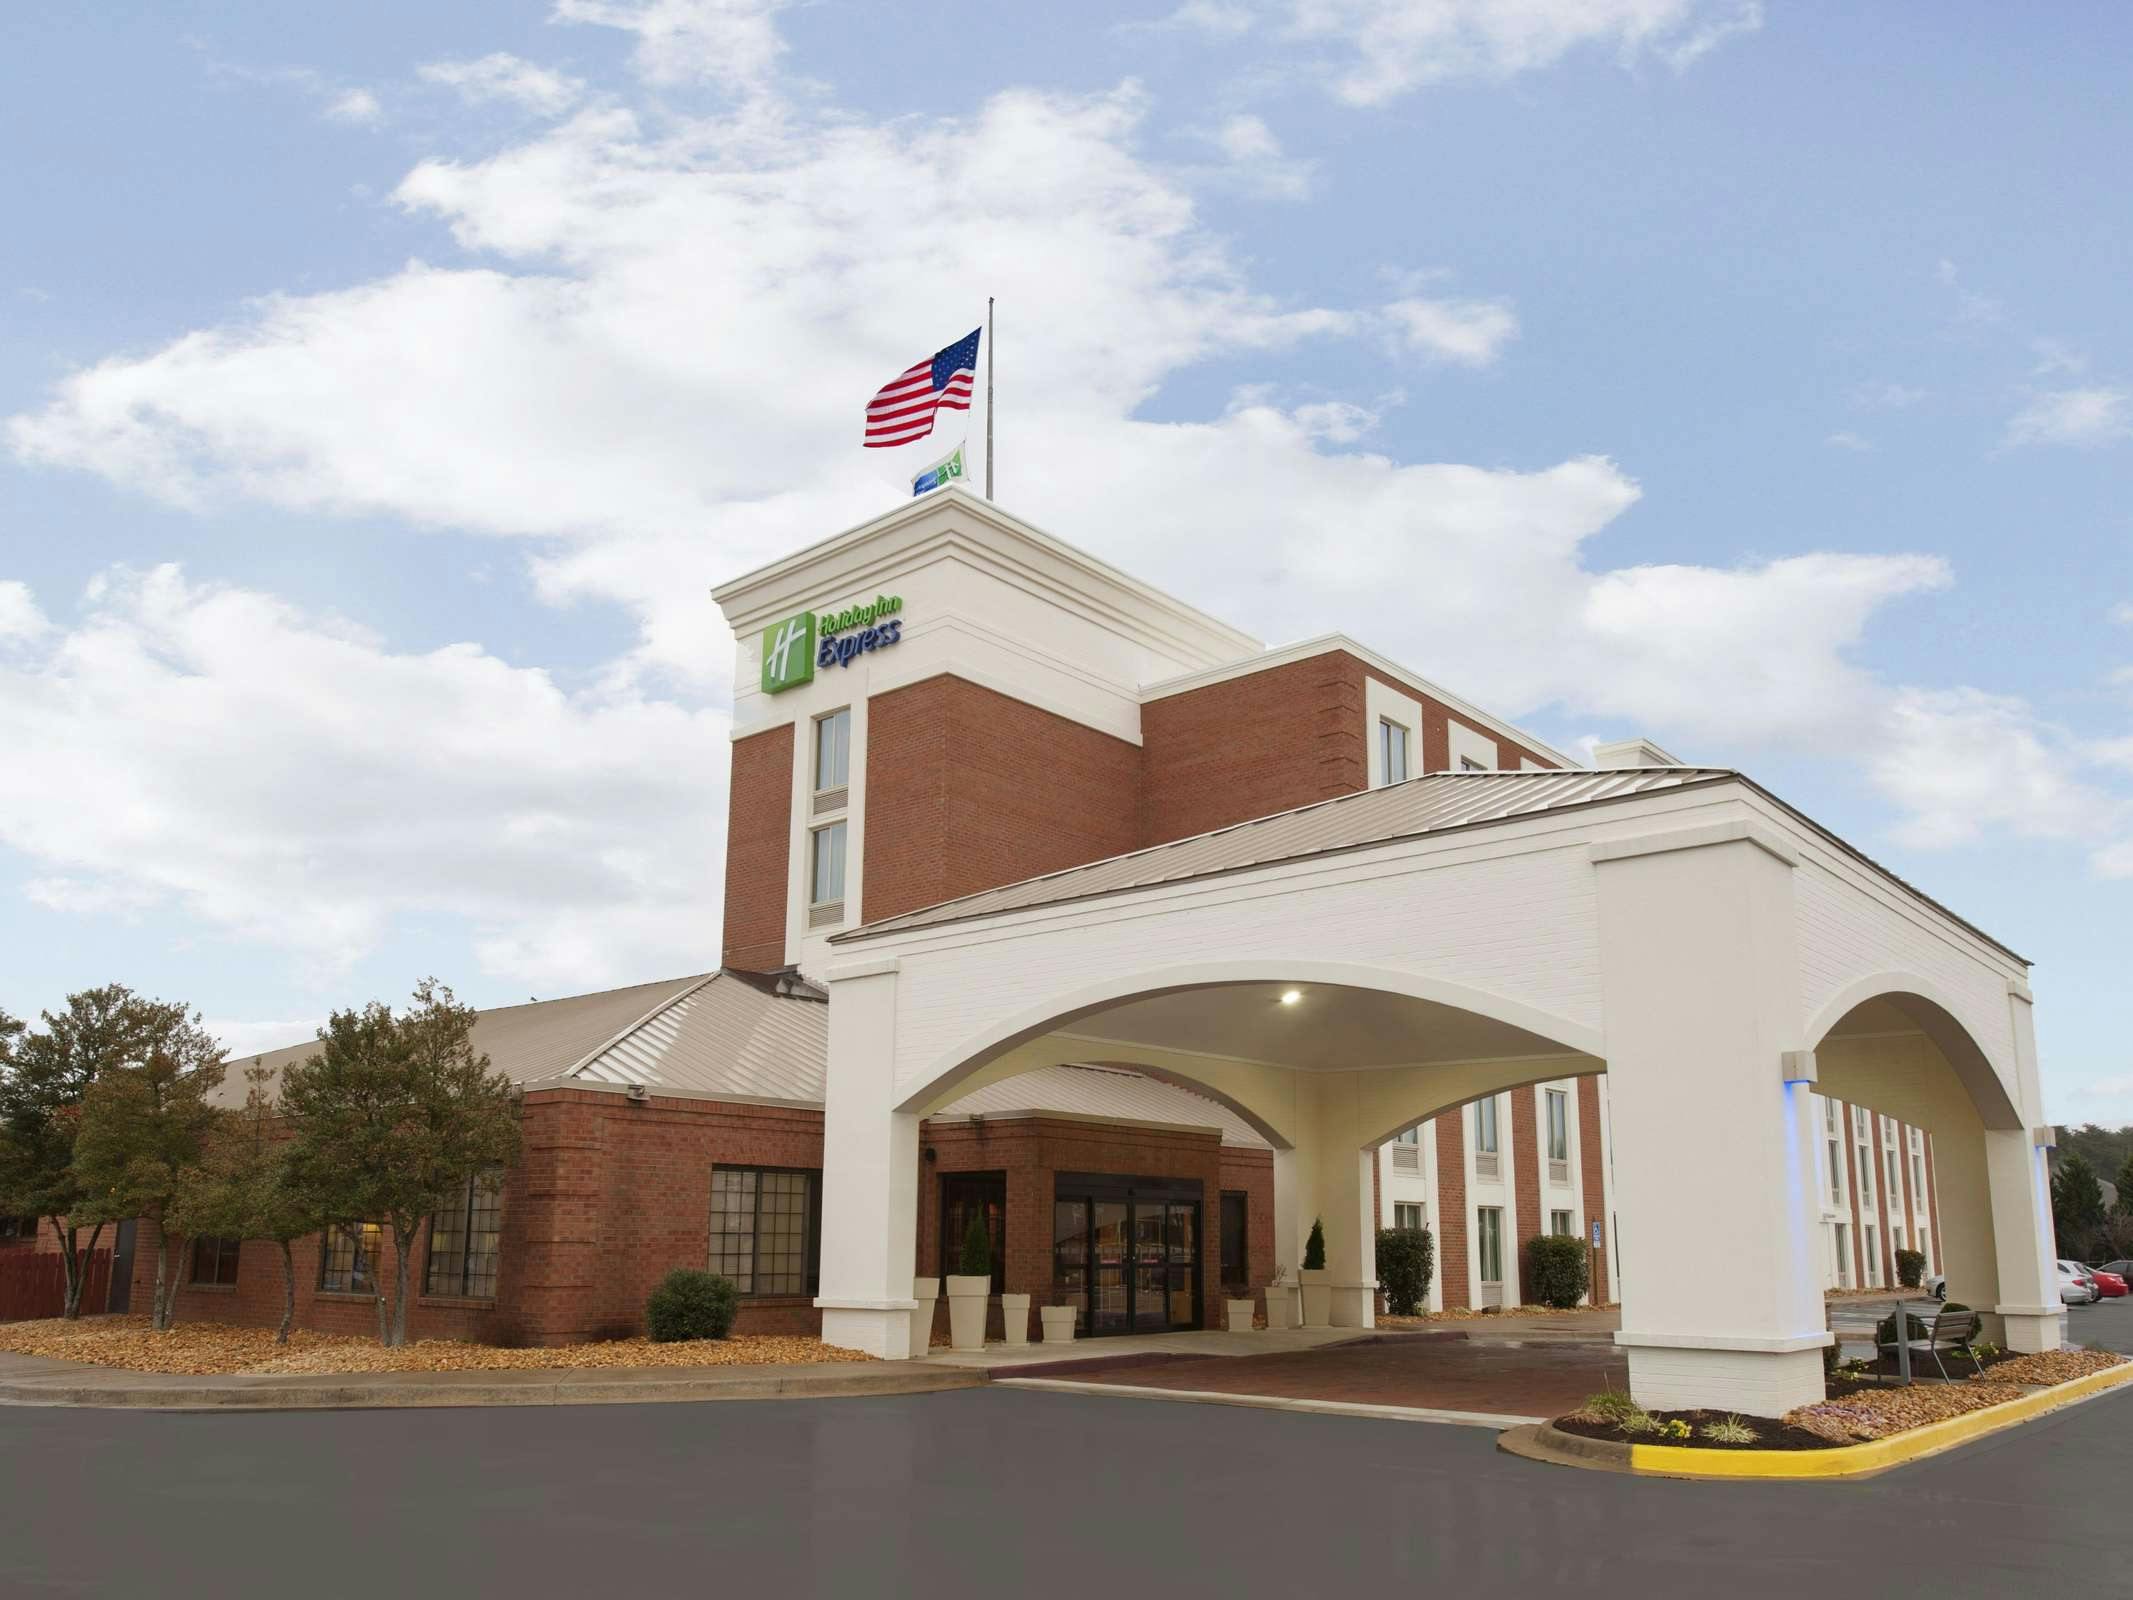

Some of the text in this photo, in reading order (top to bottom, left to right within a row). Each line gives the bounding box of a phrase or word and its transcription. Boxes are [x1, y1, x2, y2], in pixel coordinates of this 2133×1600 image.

[820, 594, 902, 636] Holiday Inn
[817, 619, 902, 668] Express
